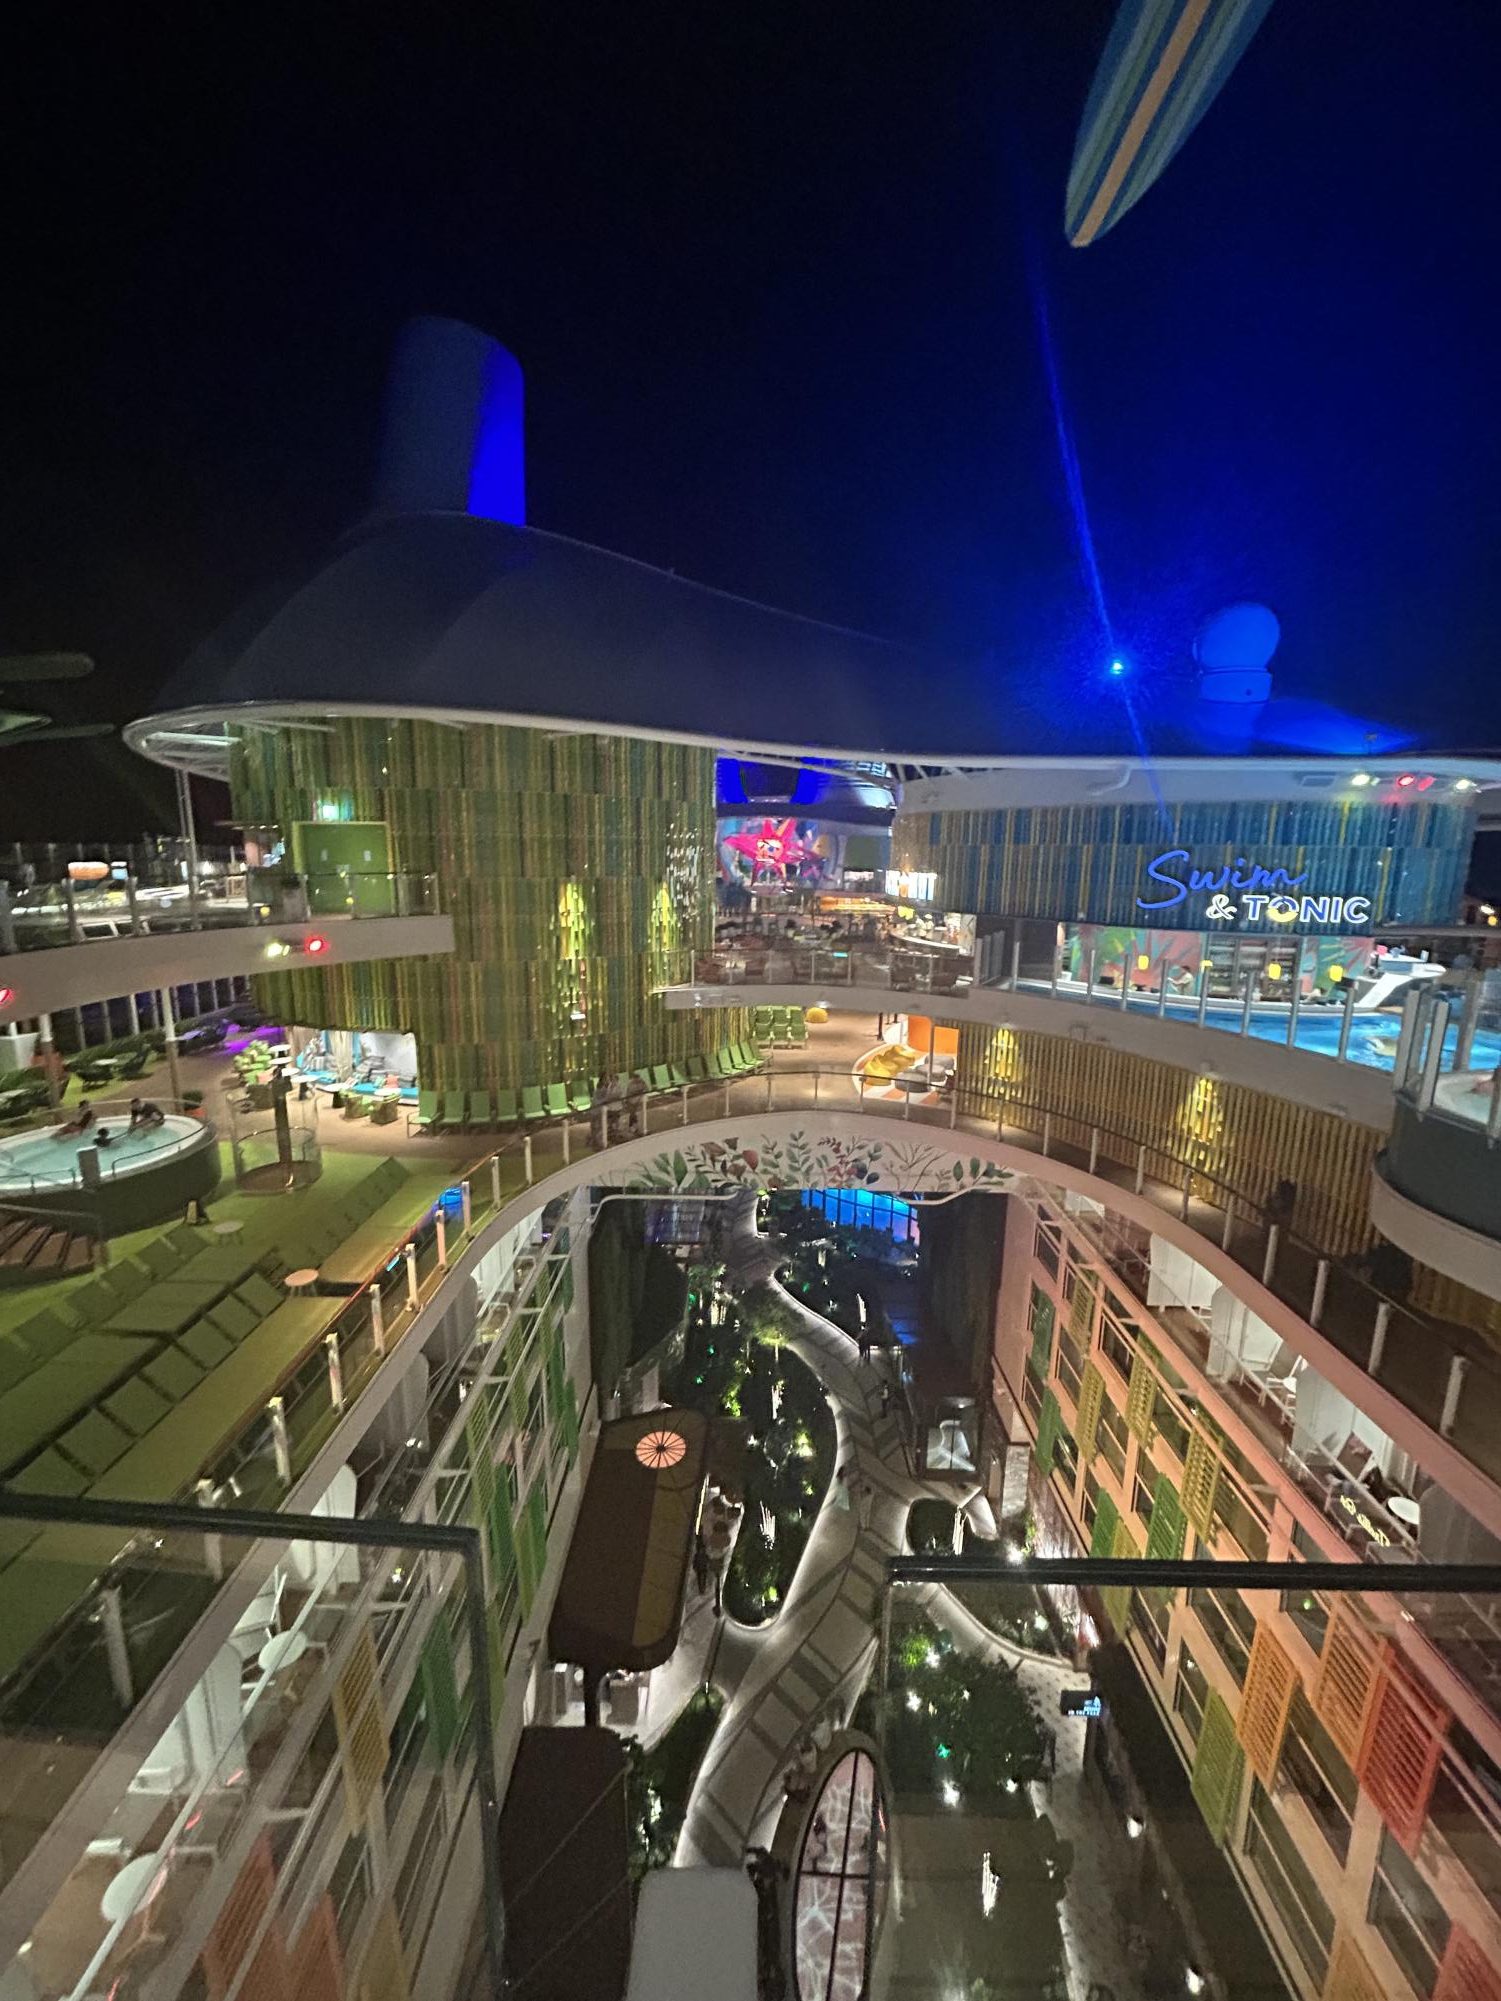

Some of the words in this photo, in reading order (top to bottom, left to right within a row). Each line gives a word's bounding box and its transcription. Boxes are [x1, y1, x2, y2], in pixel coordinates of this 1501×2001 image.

[1136, 850, 1308, 909] Swim
[1205, 894, 1238, 920] &
[1242, 894, 1371, 924] TONIC
